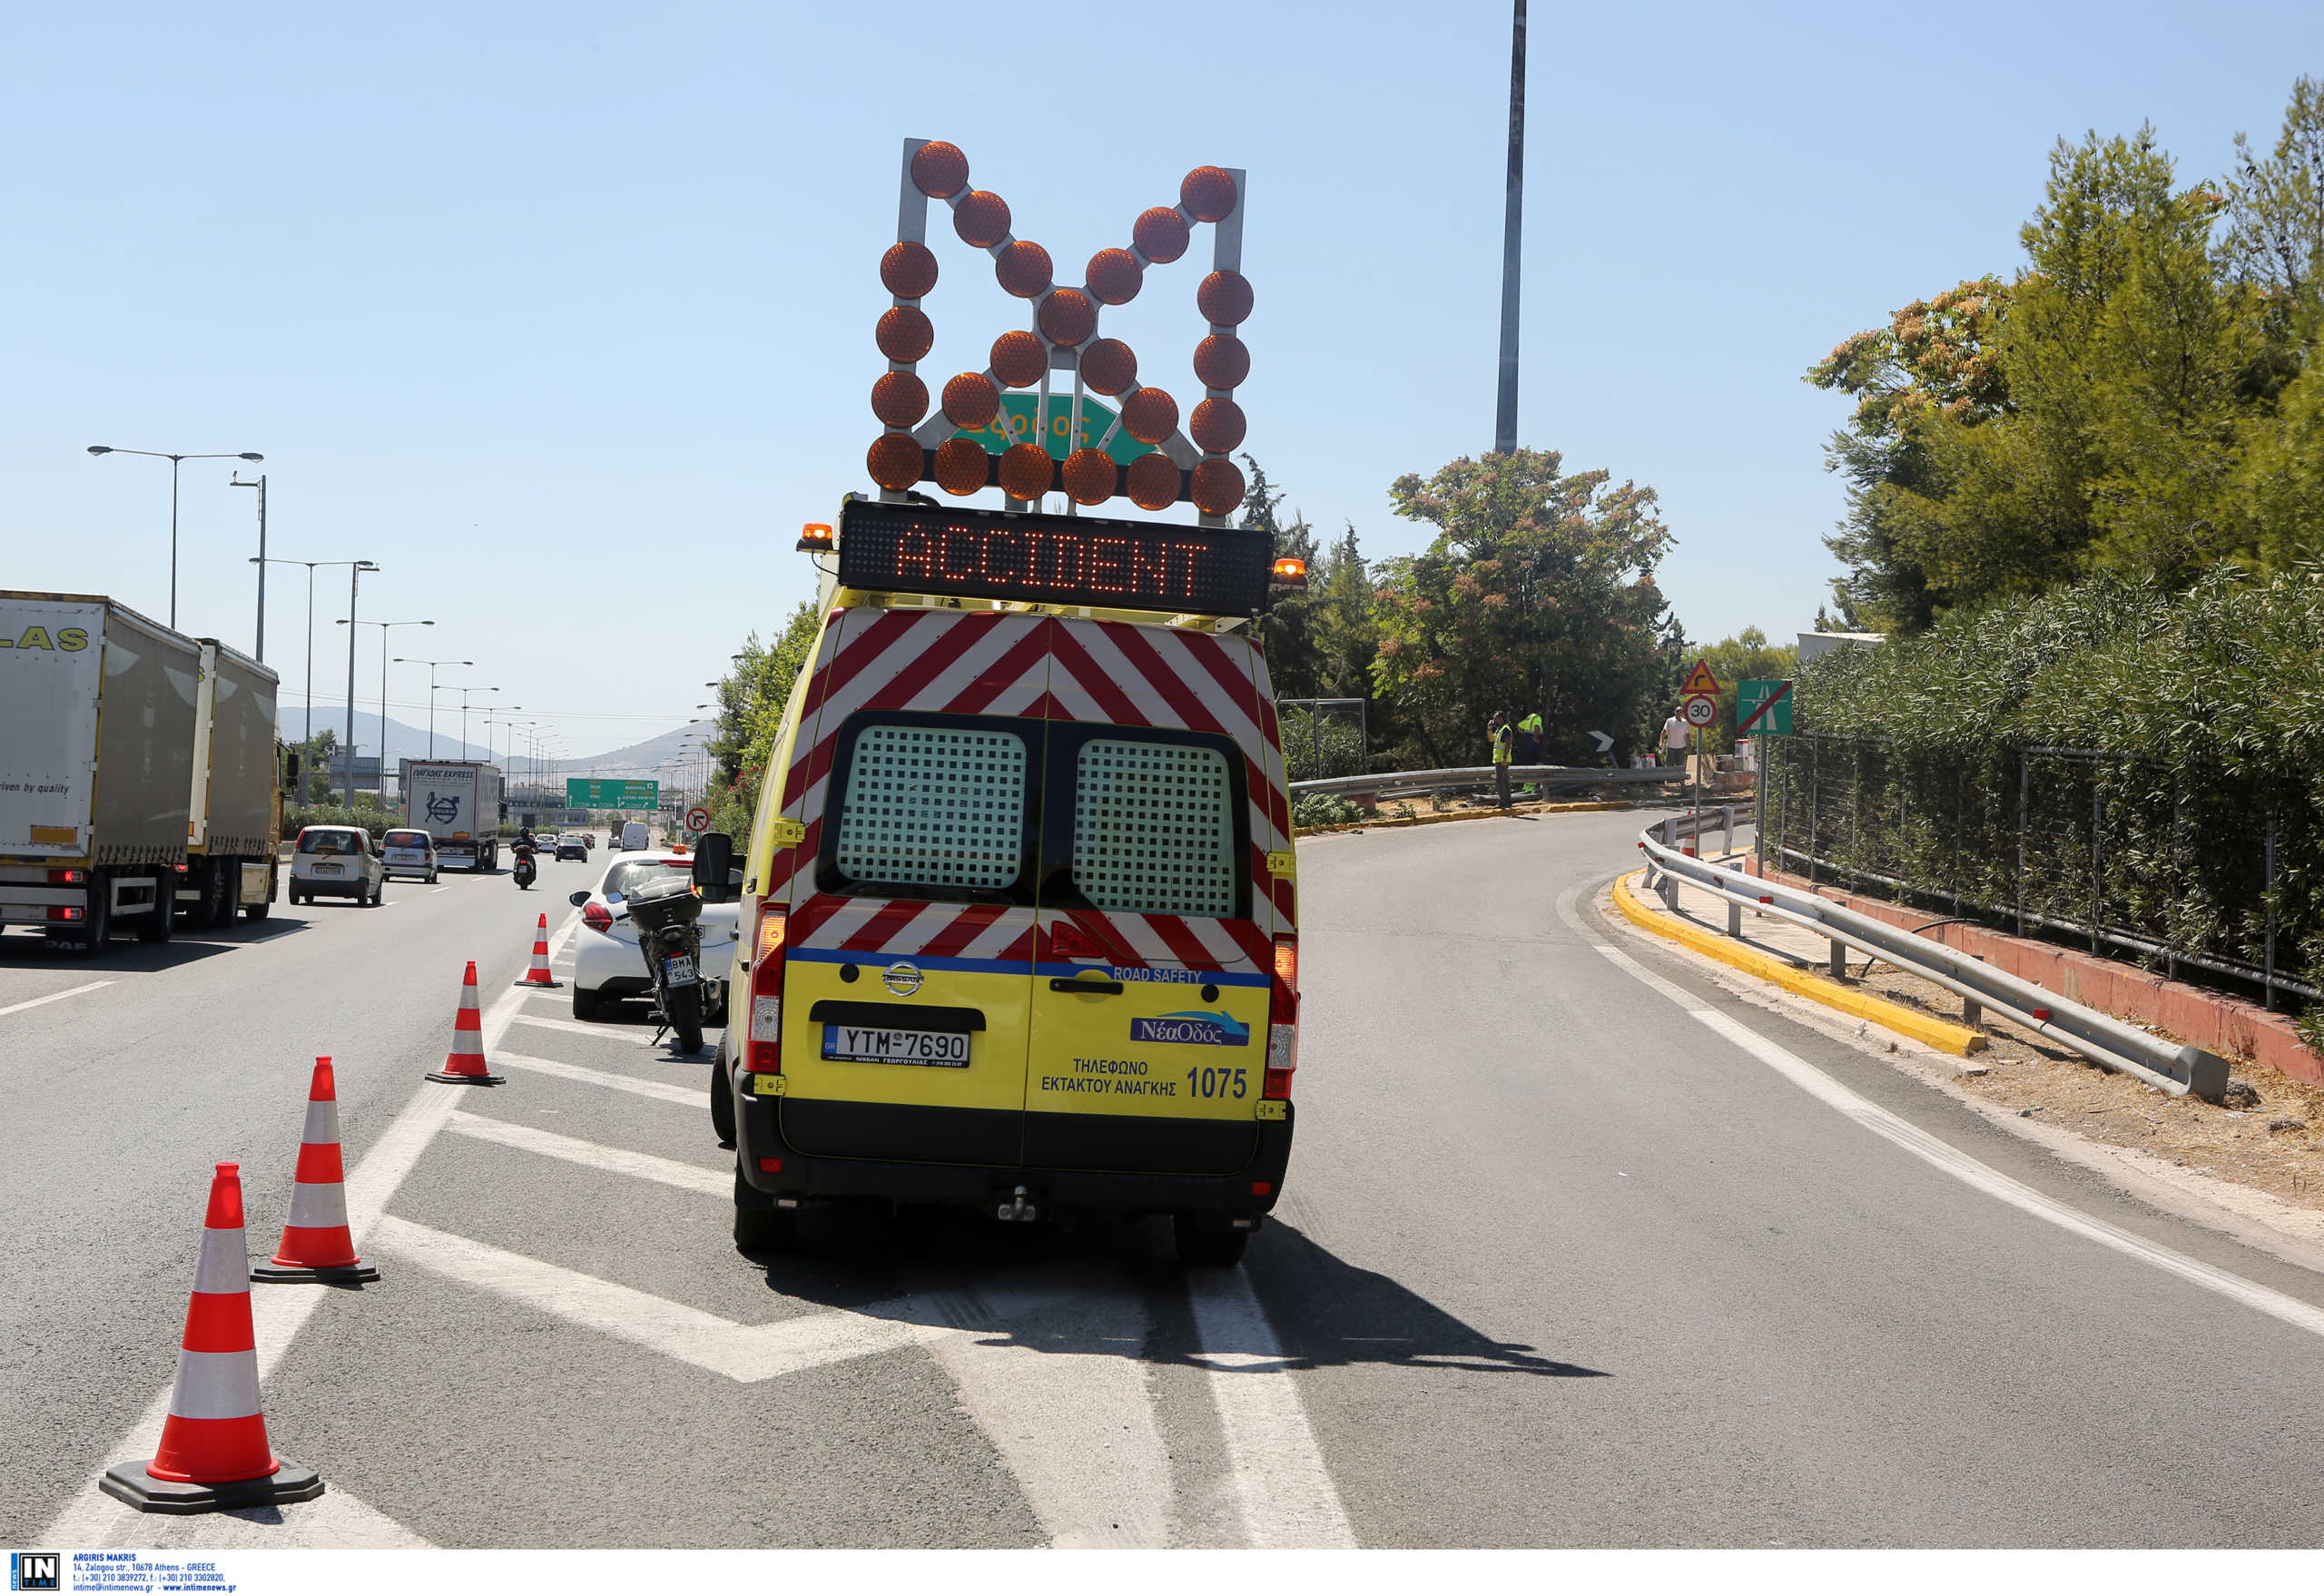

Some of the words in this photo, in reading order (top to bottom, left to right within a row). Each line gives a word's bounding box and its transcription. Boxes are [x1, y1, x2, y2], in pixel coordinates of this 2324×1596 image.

[896, 522, 1208, 598] ACCIDENT
[1690, 704, 1710, 717] 30
[443, 770, 474, 779] EXPRESS
[24, 782, 35, 793] by
[37, 783, 69, 795] quality
[672, 958, 692, 970] BMA
[675, 969, 694, 980] 543
[1114, 966, 1149, 981] ROAD
[1153, 969, 1202, 984] SAFETY
[1073, 1059, 1148, 1075] ΤΗΛΕΦΩΝΟ
[1041, 1077, 1111, 1093] ΕΚΤΑΚΤΟΥ
[1114, 1080, 1177, 1097] ΑΝΑΓΚΗΣ
[1187, 1066, 1247, 1098] 1075
